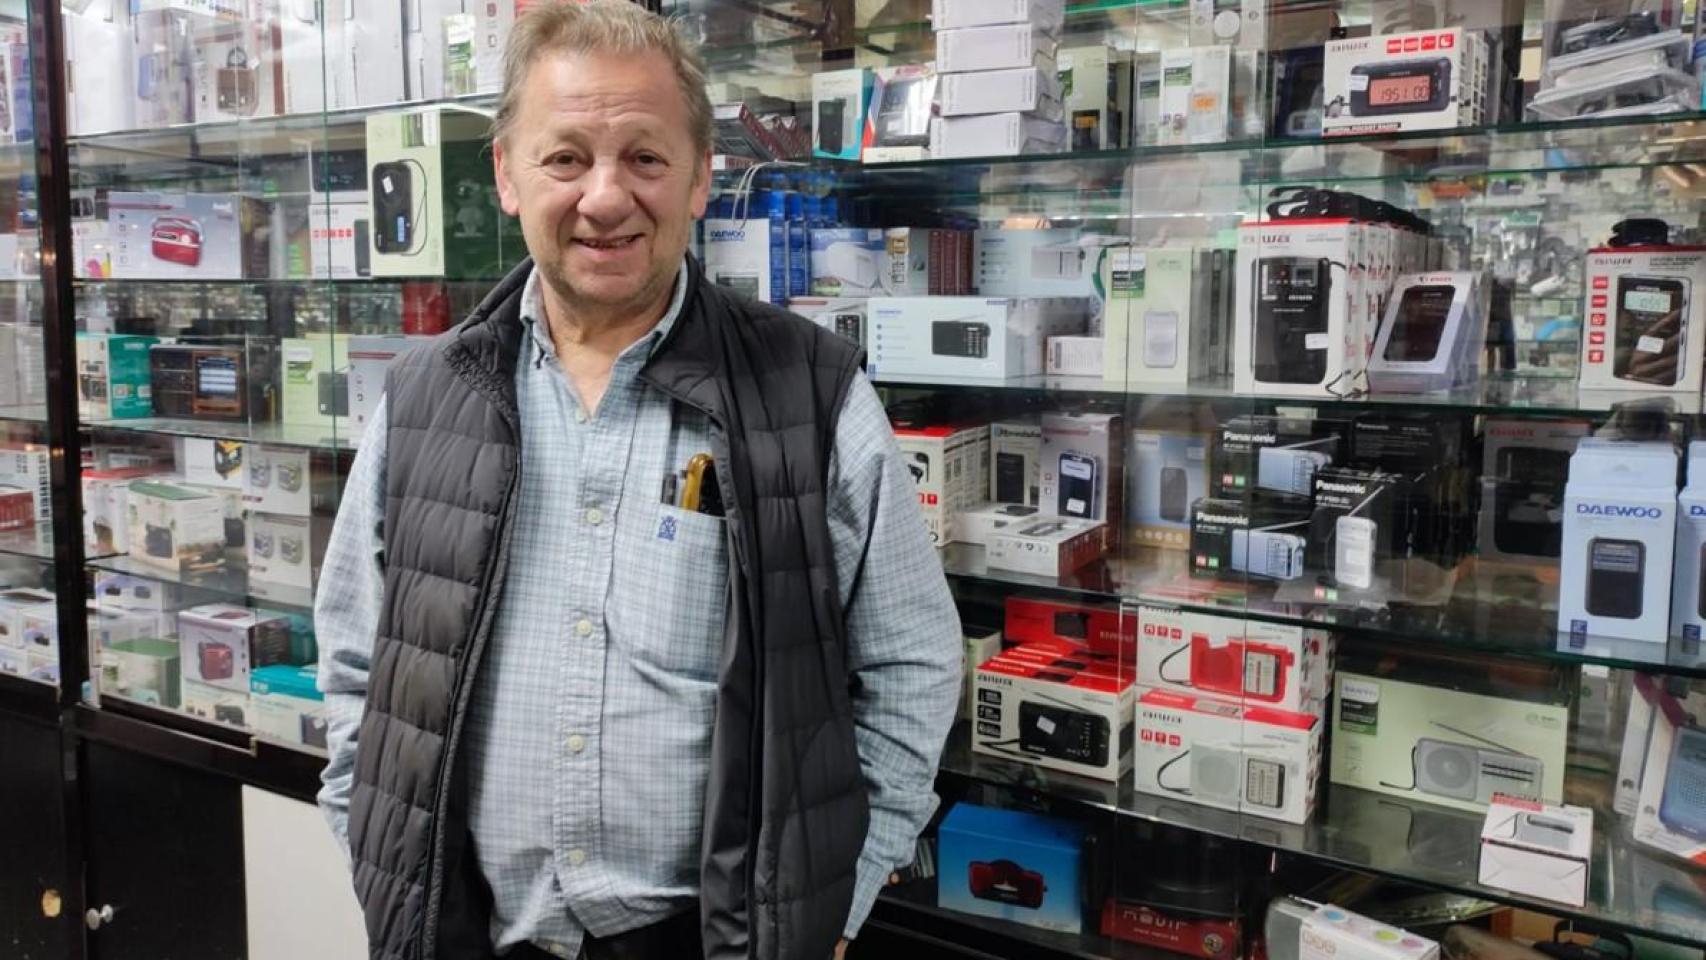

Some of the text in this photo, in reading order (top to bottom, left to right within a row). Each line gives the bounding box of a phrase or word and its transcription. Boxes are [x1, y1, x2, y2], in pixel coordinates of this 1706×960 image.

[1223, 431, 1276, 443] Panasonic
[1316, 480, 1366, 494] Panasonic
[1576, 504, 1662, 519] DAEWOO
[1197, 512, 1249, 525] Panasonic
